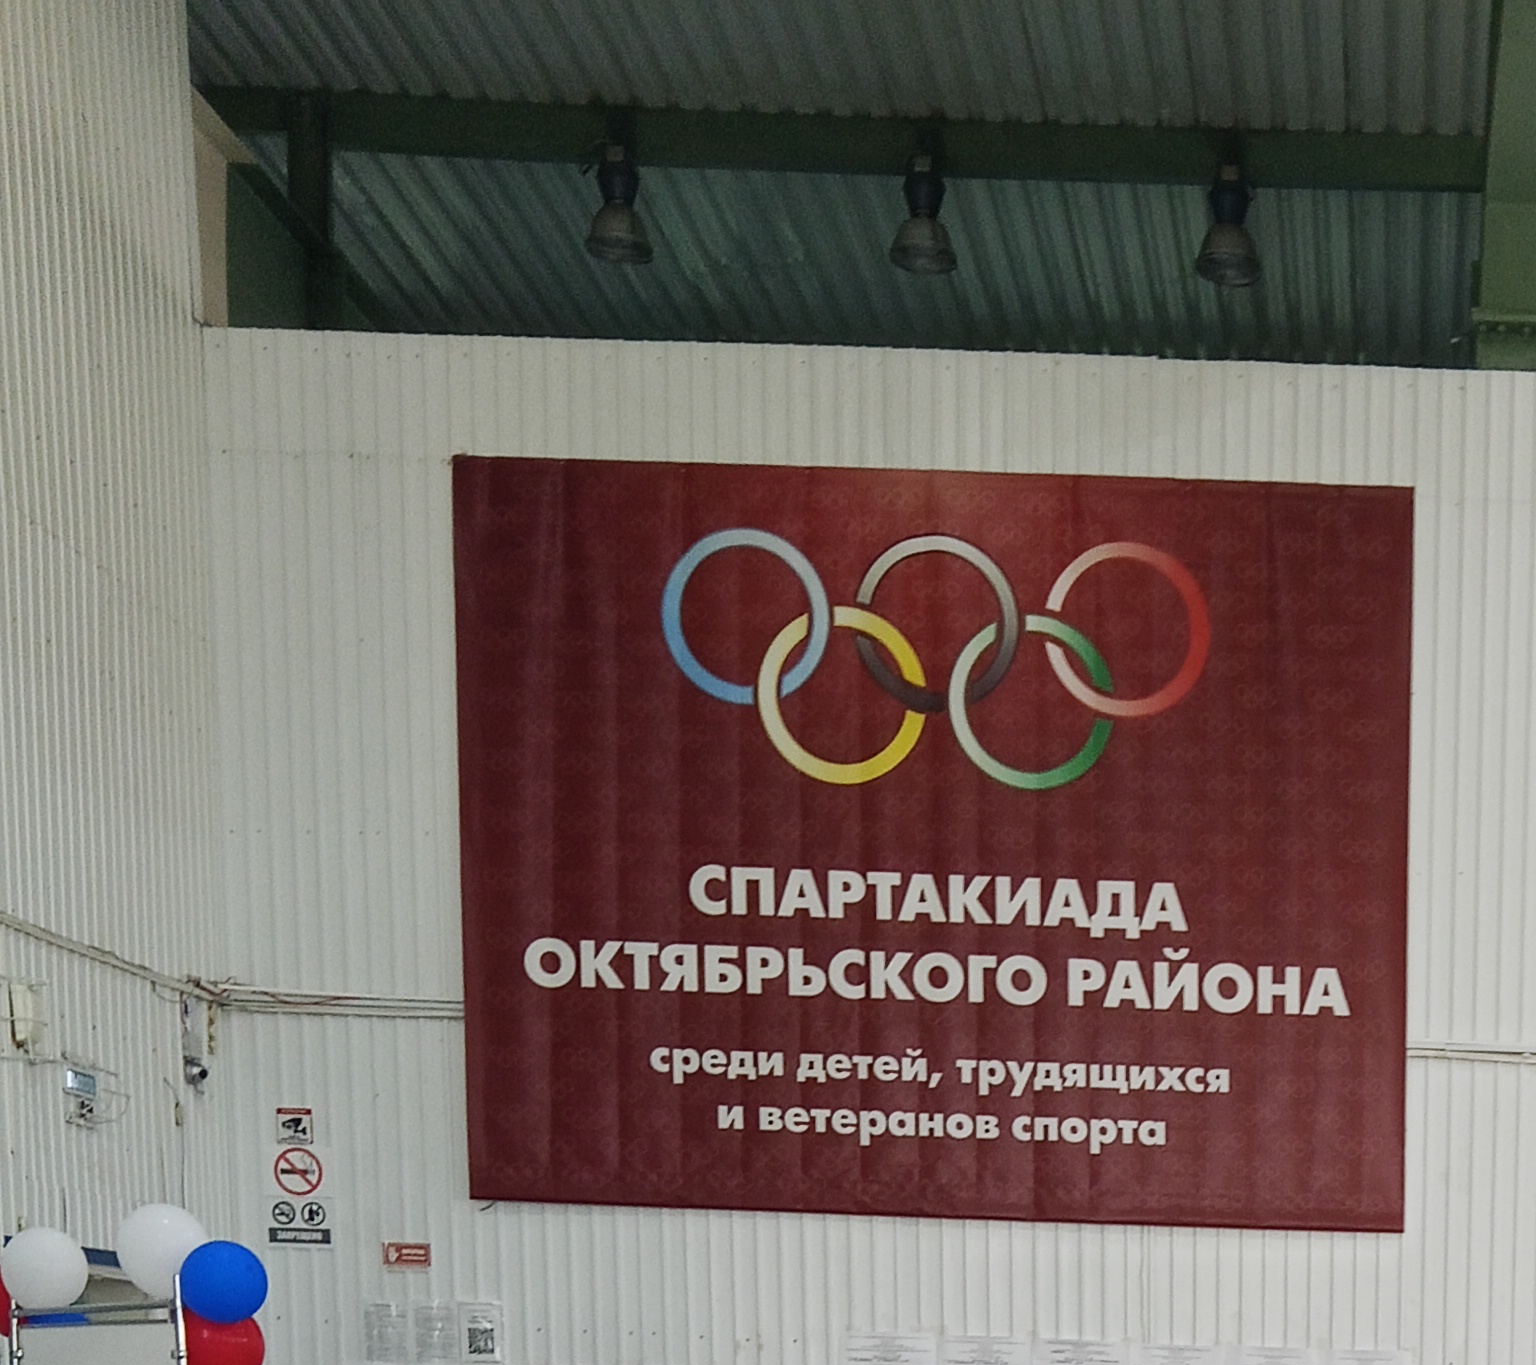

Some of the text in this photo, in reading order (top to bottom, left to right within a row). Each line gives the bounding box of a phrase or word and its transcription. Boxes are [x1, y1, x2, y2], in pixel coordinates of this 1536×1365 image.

[689, 864, 1188, 938] СПАРТАКИАДА
[523, 938, 1351, 1018] ОКТЯБРЬСКОГО РАЙОНА
[650, 1046, 1231, 1097] среди детей, трудящихся
[717, 1105, 1167, 1154] и ветеранов спорта
